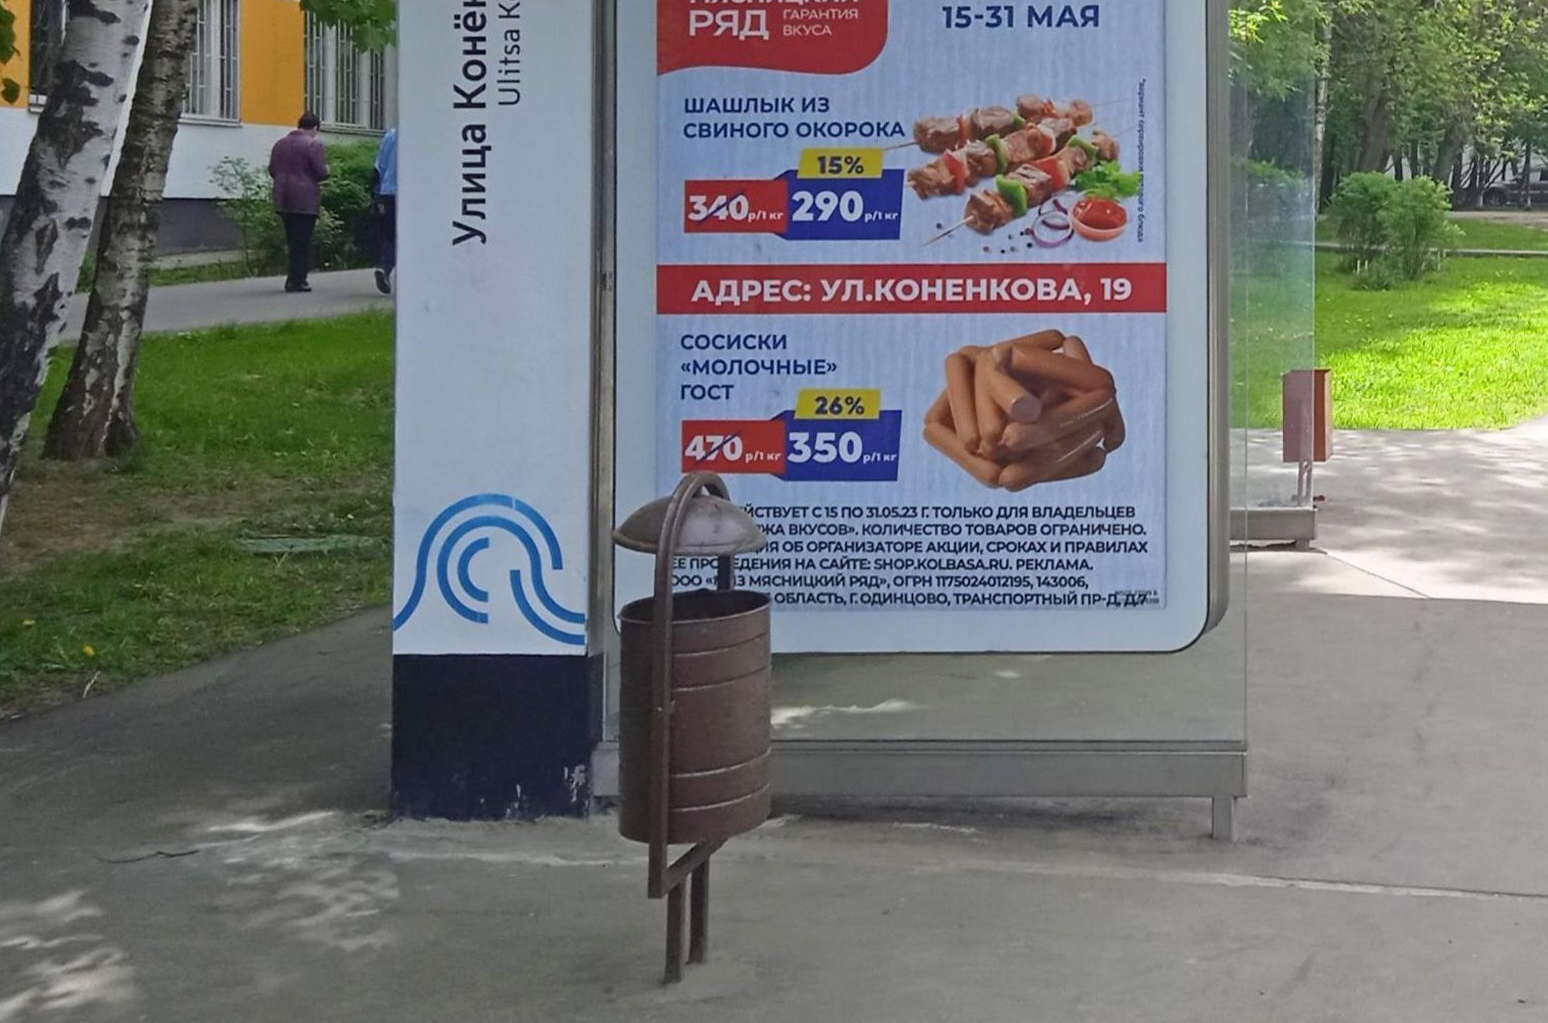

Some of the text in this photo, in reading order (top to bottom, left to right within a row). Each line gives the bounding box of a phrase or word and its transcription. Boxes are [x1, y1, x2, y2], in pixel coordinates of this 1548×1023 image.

[782, 8, 859, 20] ГАРАНТИЯ
[942, 4, 1100, 29] 15-31 МАЯ
[689, 9, 769, 41] РЯД
[782, 24, 833, 36] ВКУСА
[497, 28, 521, 106] Ulitsa
[684, 97, 830, 114] ШАШЛЫК ИЗ
[683, 121, 906, 139] СВИНОГО ОКОРОКА
[817, 155, 865, 175] 15%
[452, 122, 492, 246] Улица
[691, 277, 1132, 306] АДРЕС: УЛ.КОНЕНКОВА, 19
[680, 333, 787, 351] СОСИСКИ
[680, 358, 838, 376] «МОЛОЧНЫЕ»
[680, 384, 735, 401] ГОСТ
[814, 395, 865, 416] 26%
[766, 453, 782, 461] кг
[742, 503, 1136, 521] ЙСТВУЕТ С 15 ПО 31.05.23 Г. ТОЛЬКО ДЛЯ ВЛАДЕЛЬЦЕВ
[788, 523, 859, 536] ВКУСОВ».
[861, 523, 963, 536] КОЛИЧЕСТВО
[965, 523, 1038, 536] ТОВАРОВ
[1040, 523, 1147, 537] ОГРАНИЧЕНО.
[782, 540, 804, 553] ОБ
[806, 540, 923, 554] ОРГАНИЗАТОРЕ
[926, 541, 984, 556] АКЦИИ,
[986, 541, 1047, 554] СРОКАХ
[1050, 541, 1061, 553] И
[1064, 541, 1148, 554] ПРАВИЛАХ
[690, 558, 792, 572] ПРОЕДЕНИЯ
[795, 558, 817, 570] НА
[819, 555, 871, 570] САЙТЕ:
[873, 558, 1013, 571] SHOP.KOLBASA.RU.
[1016, 558, 1094, 571] РЕКЛАМА.
[749, 573, 846, 589] МЯСНИЦКИЙ
[849, 575, 891, 590] РЯД»,
[893, 575, 933, 588] ОГРН
[936, 575, 1034, 590] 1175024012195,
[1036, 575, 1089, 590] 143006,
[774, 592, 848, 607] ОБЛАСТЬ,
[953, 590, 1078, 606] ТРАНСПОРТНЫЙ
[1080, 593, 1122, 608] ПР-Д,
